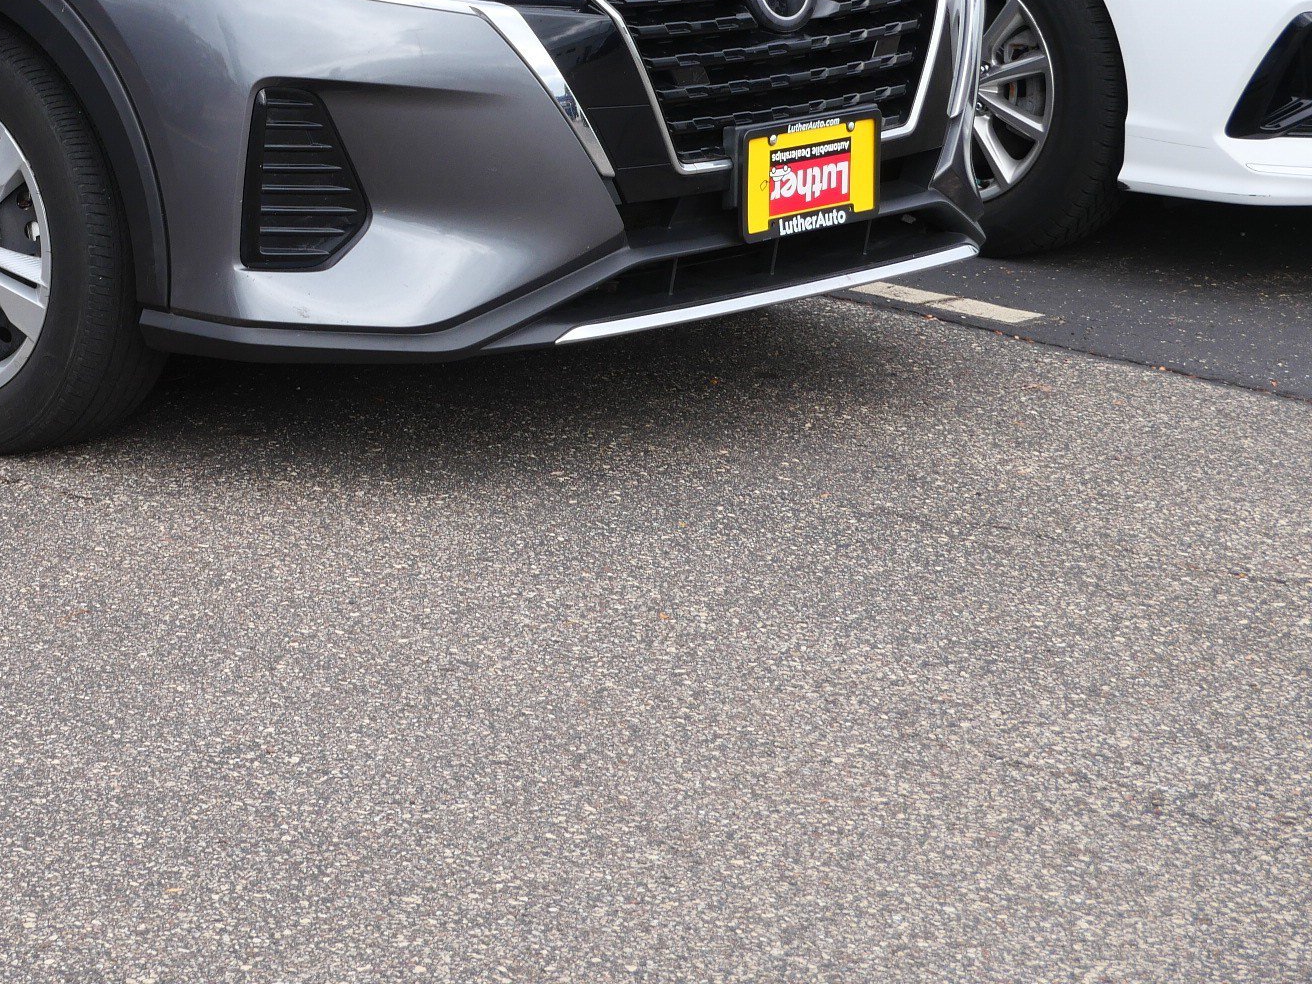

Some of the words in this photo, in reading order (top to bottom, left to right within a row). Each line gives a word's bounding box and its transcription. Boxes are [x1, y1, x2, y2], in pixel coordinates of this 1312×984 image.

[787, 118, 841, 134] LutherAuto.com
[771, 148, 811, 163] Dealerships
[812, 141, 850, 156] Automobile
[770, 161, 849, 203] Luther
[779, 209, 846, 236] LutherAuto
